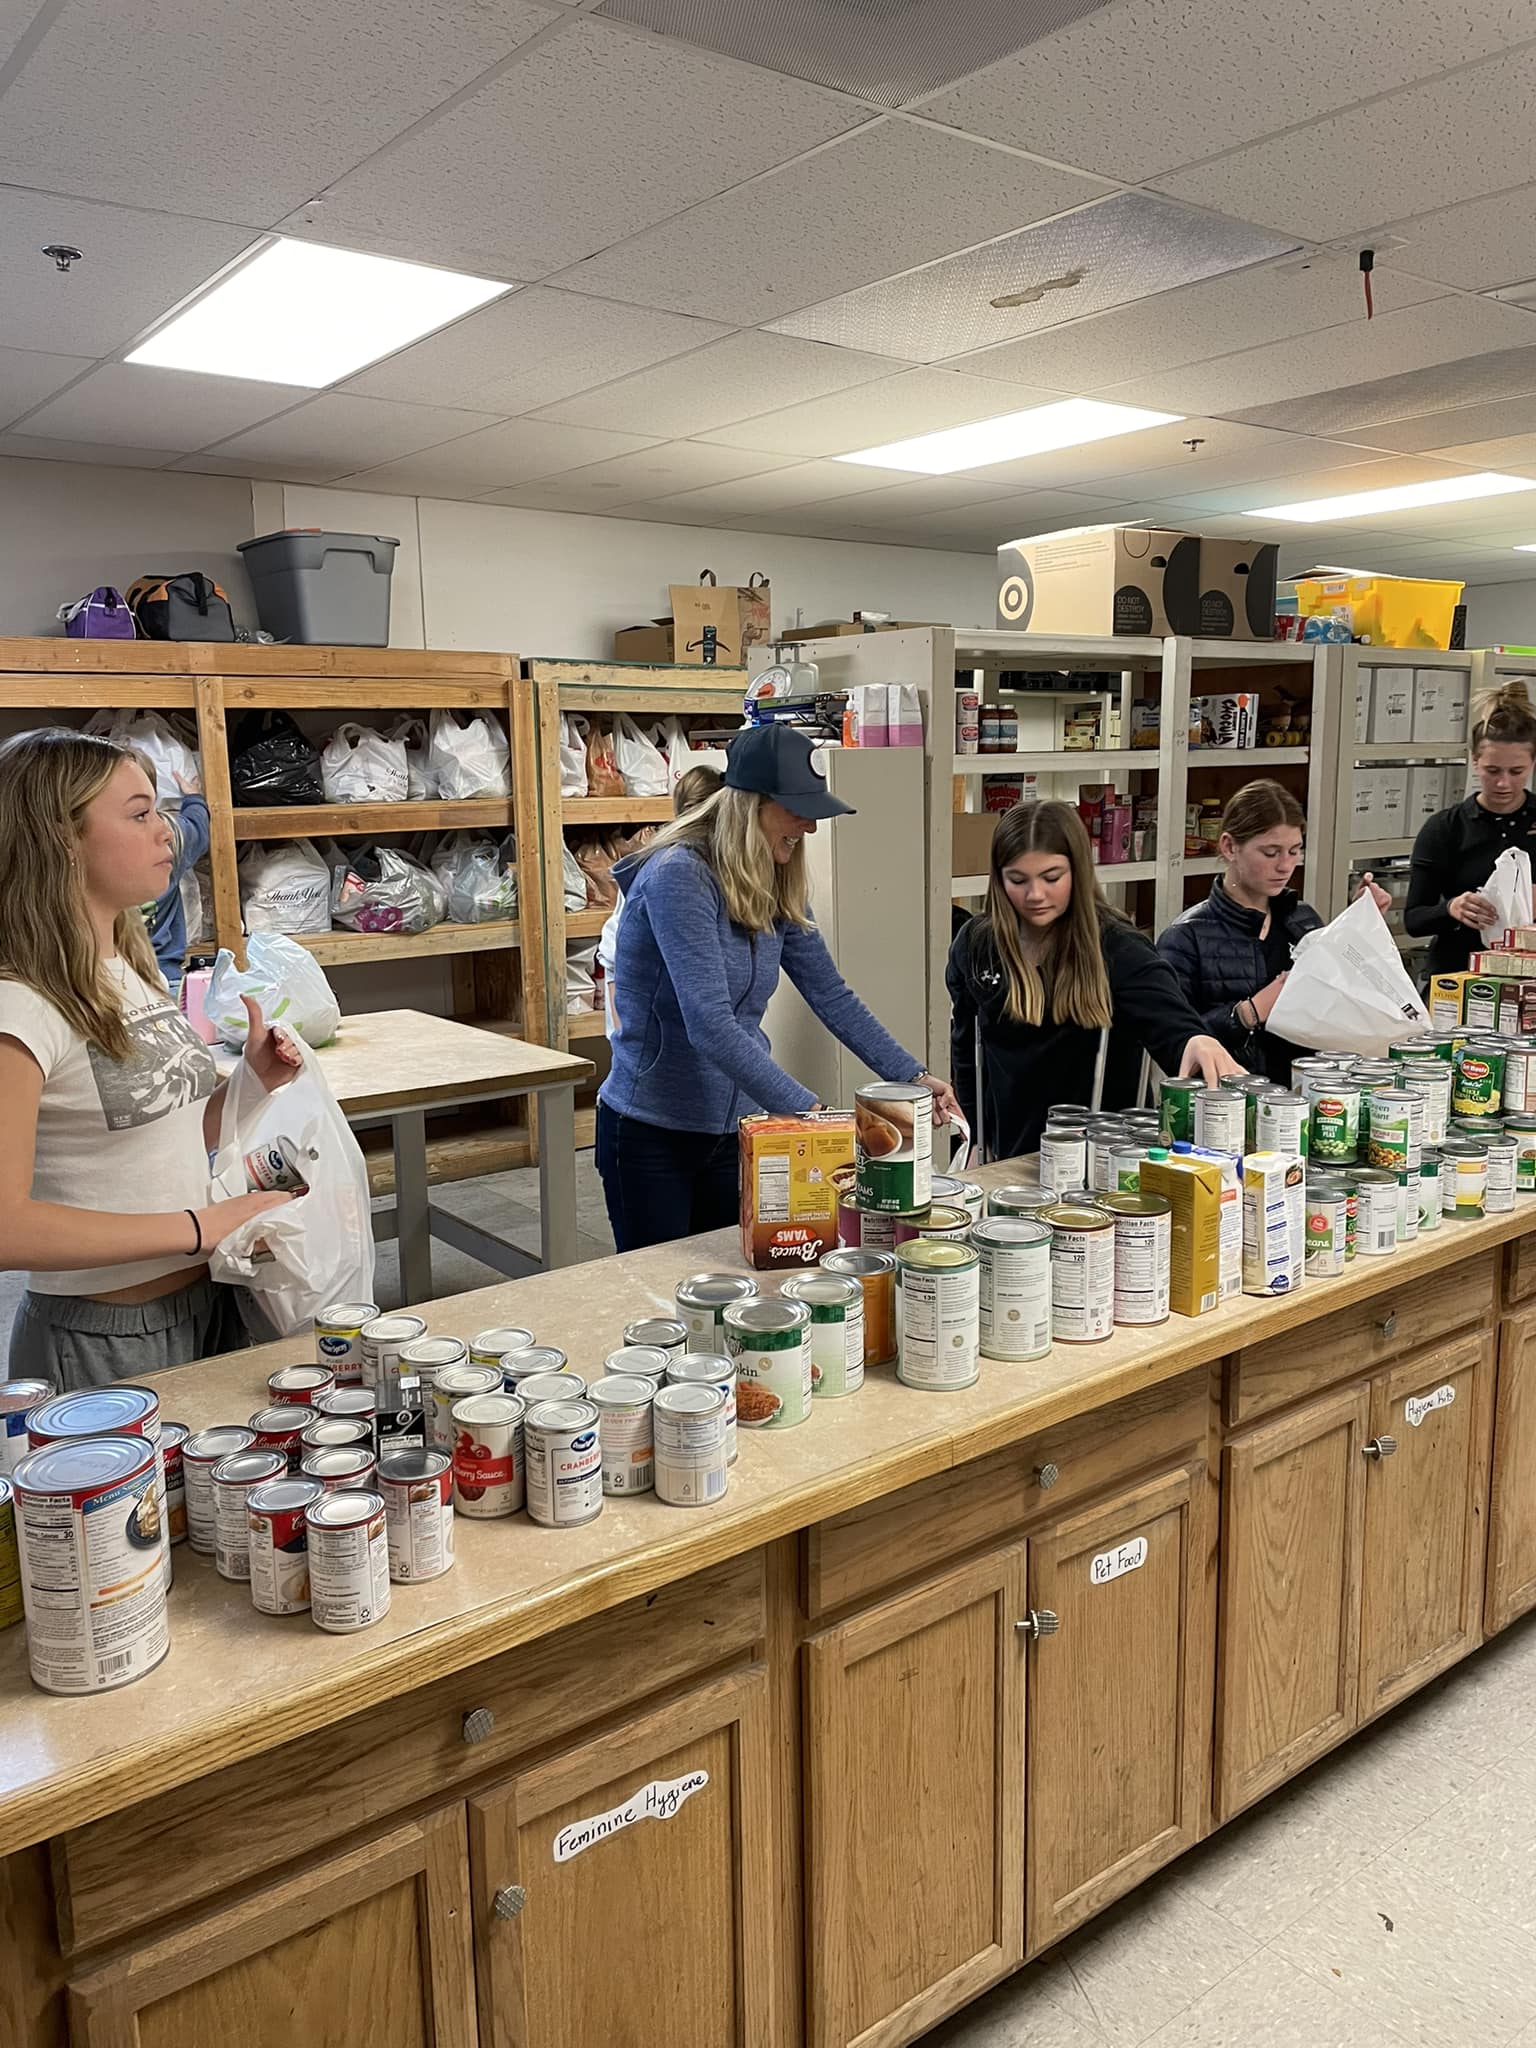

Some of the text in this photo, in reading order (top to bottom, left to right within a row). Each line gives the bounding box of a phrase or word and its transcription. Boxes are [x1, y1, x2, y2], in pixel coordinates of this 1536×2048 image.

[265, 888, 322, 902] Thank You
[776, 1229, 809, 1242] YAMS
[1144, 1238, 1155, 1246] 120
[1306, 1239, 1330, 1247] eans
[769, 1239, 823, 1262] Bruce's
[1073, 1254, 1086, 1262] 120
[331, 1363, 363, 1372] BERRY
[475, 1470, 504, 1480] Sauce
[92, 1490, 121, 1506] Menu
[1094, 1540, 1142, 1579] Pet Food
[558, 1775, 705, 1856] Feminine Hygiene
